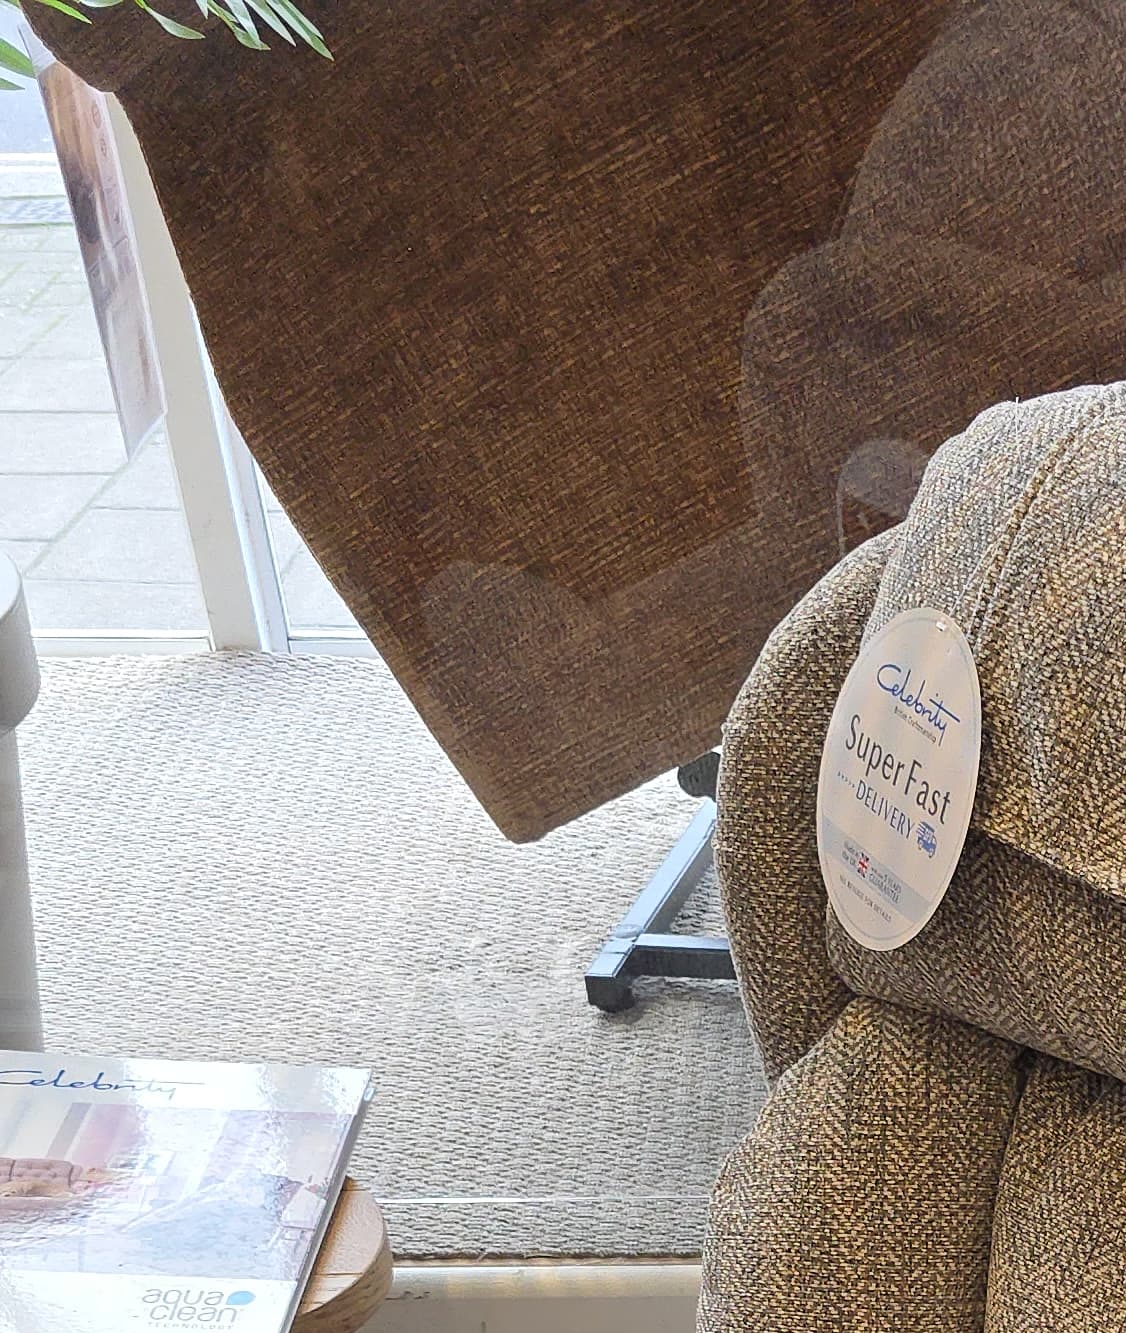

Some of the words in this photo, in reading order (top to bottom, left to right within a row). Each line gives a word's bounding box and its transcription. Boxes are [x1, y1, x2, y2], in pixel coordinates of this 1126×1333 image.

[876, 664, 961, 747] Celebrity
[856, 780, 916, 840] DELIVERY
[142, 1288, 225, 1311] aqua
[150, 1301, 238, 1323] clean
